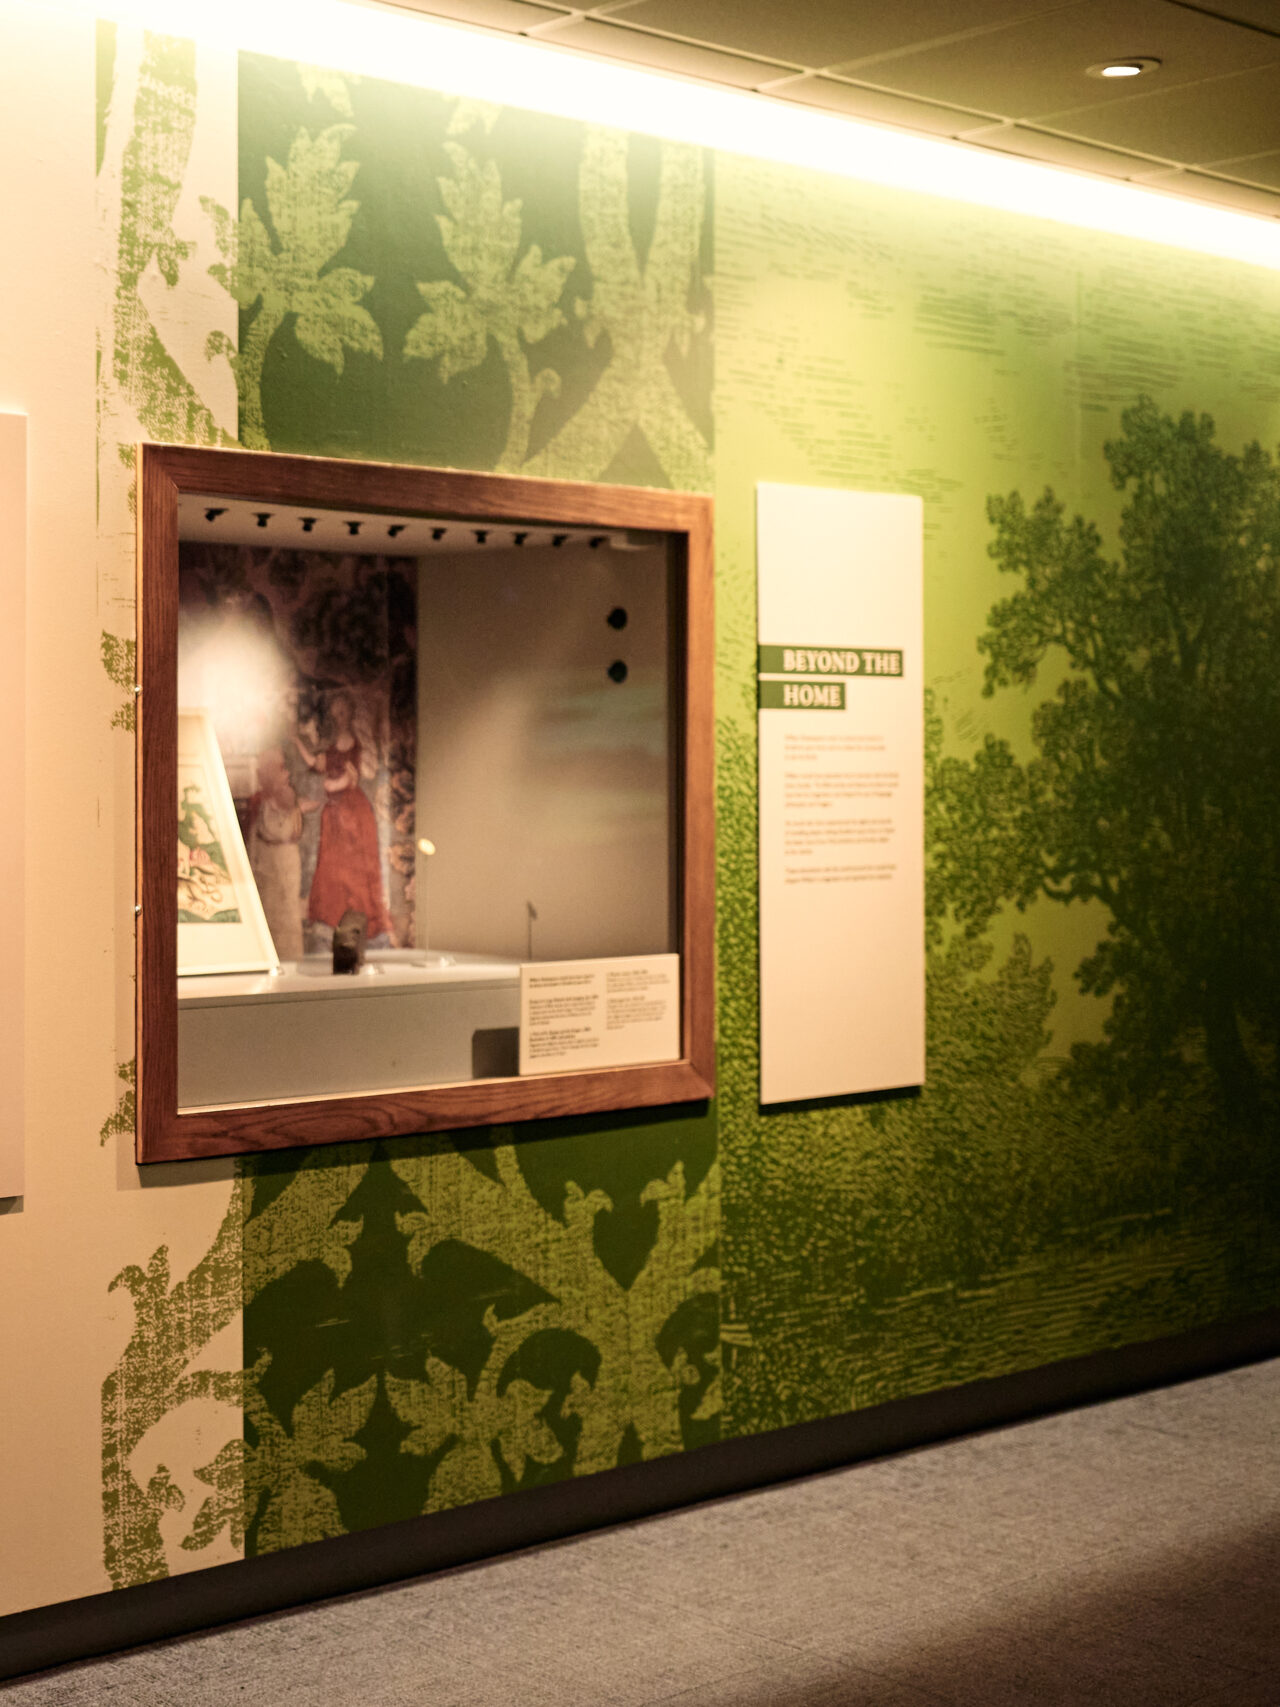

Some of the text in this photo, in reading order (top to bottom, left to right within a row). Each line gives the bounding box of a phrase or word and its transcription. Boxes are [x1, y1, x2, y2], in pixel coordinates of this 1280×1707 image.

[782, 649, 901, 674] BEYOND THE
[783, 684, 842, 707] HOME
